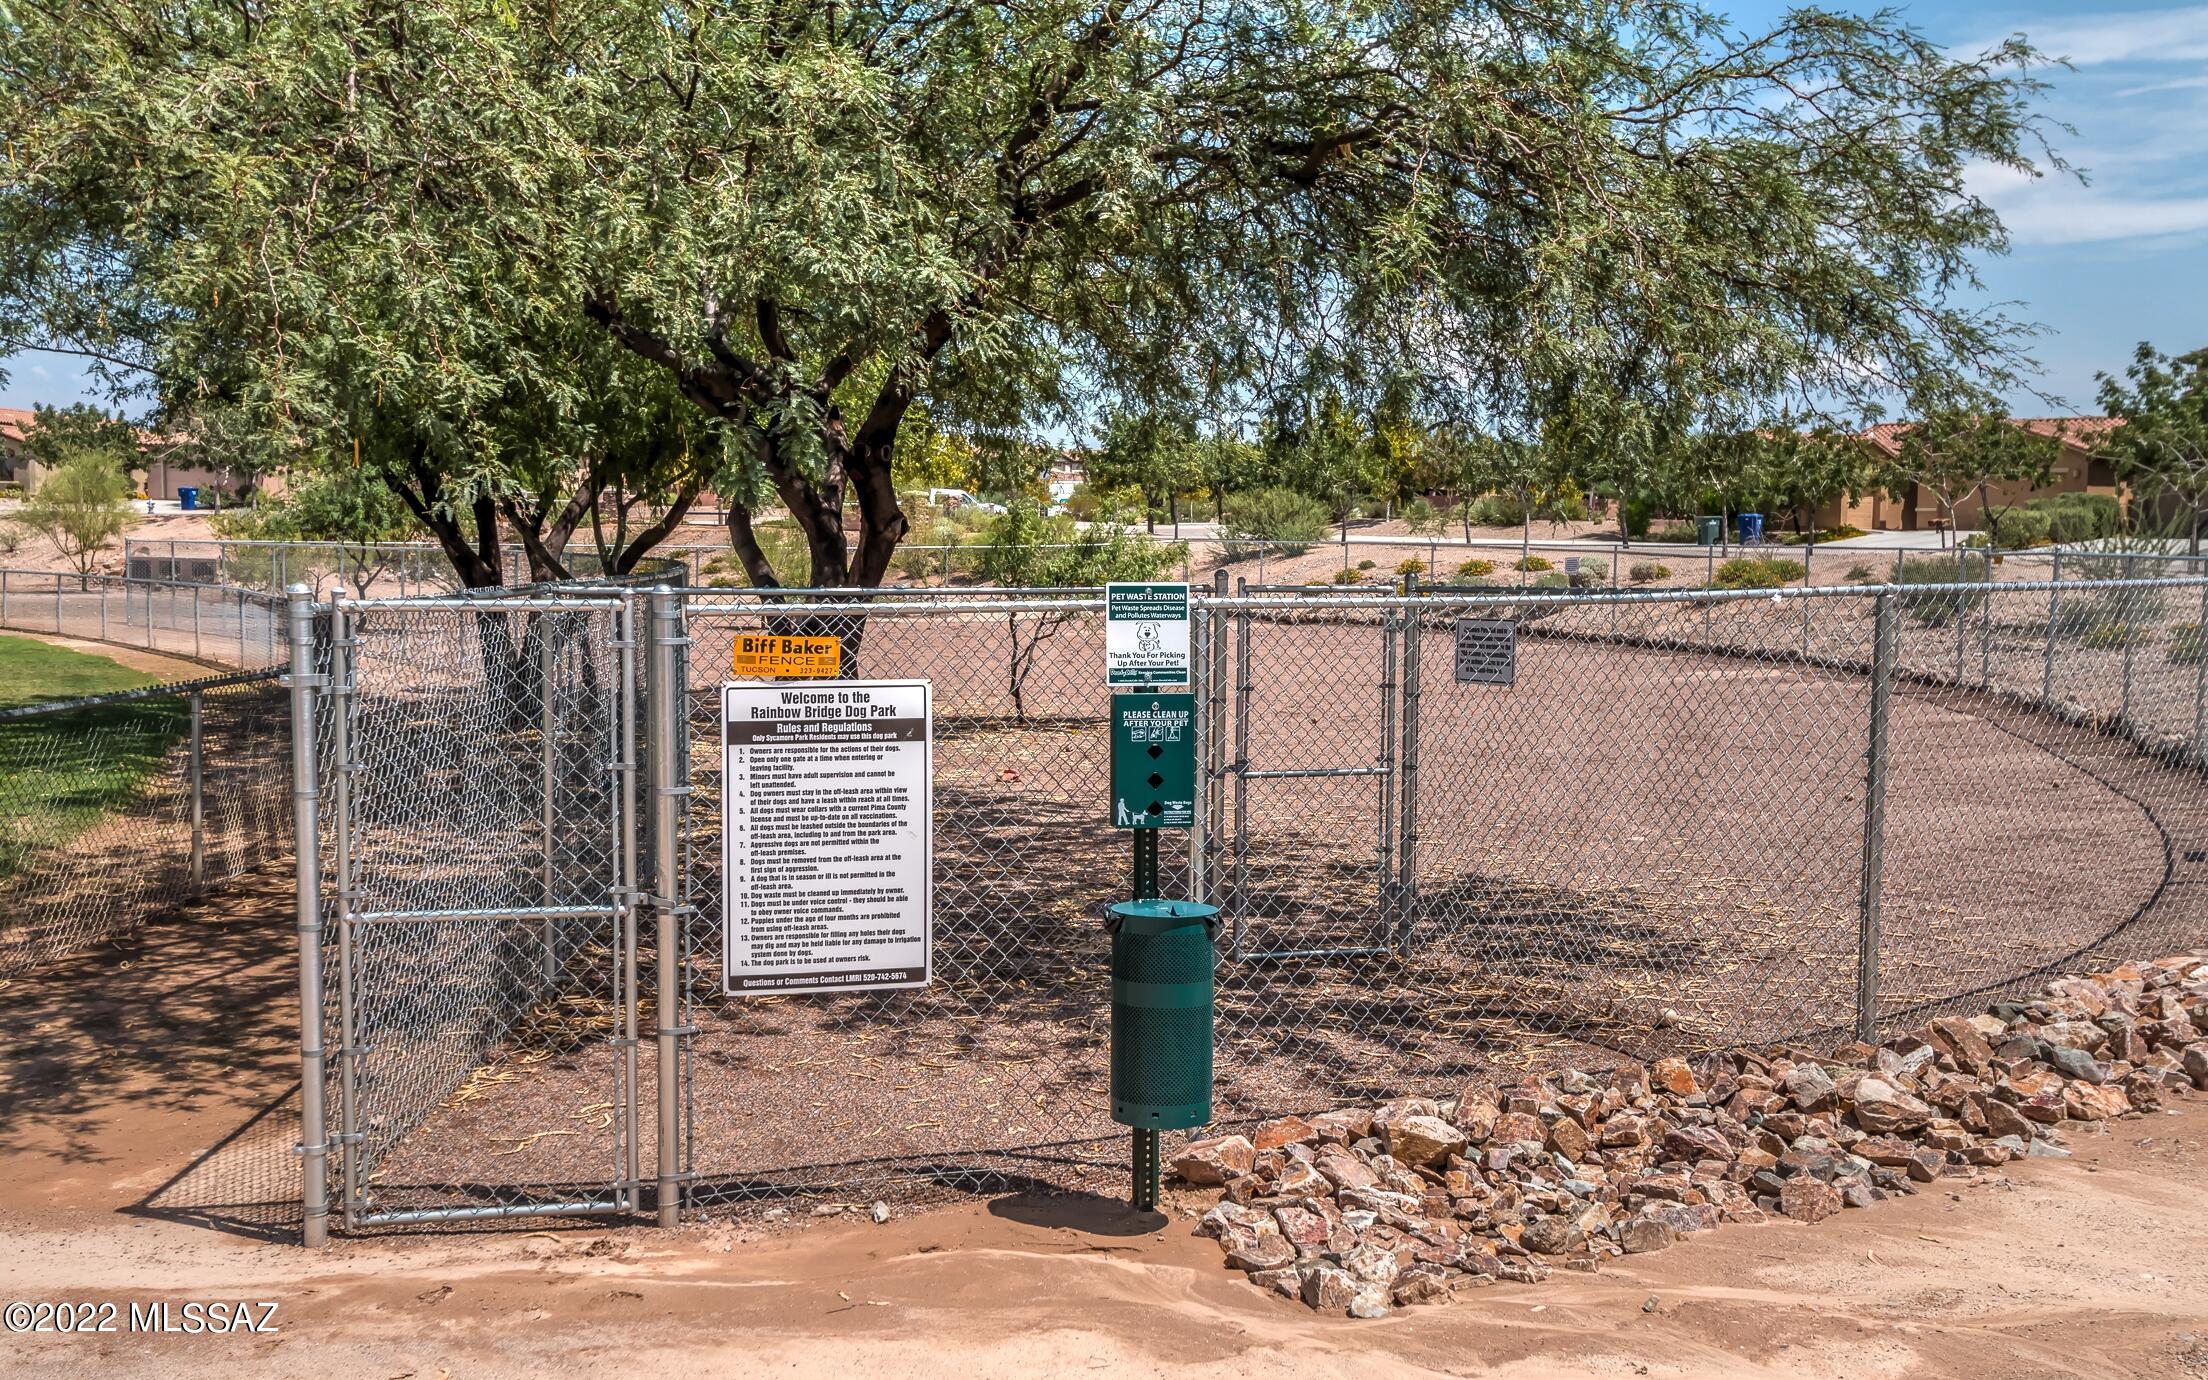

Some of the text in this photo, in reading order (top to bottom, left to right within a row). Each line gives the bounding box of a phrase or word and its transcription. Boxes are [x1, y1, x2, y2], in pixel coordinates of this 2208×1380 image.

[743, 638, 832, 654] Biff Baker
[759, 656, 815, 665] FENCE
[780, 691, 869, 704] Welcome to the
[751, 704, 896, 719] Rainbow Bridge Dog Park
[777, 721, 872, 732] Rules and Regulations
[784, 746, 818, 755] responsible
[749, 764, 794, 772] leaving facility.
[819, 771, 853, 779] supervision
[750, 841, 782, 849] Aggressive
[821, 838, 849, 847] permitted
[777, 848, 806, 856] premises.
[750, 858, 765, 866] Dogs
[784, 864, 818, 873] aggression.
[840, 888, 876, 896] immediately
[758, 909, 772, 917] obey
[775, 958, 788, 966] park
[743, 978, 774, 986] Questions
[784, 976, 818, 984] Comments
[819, 974, 844, 983] Contact
